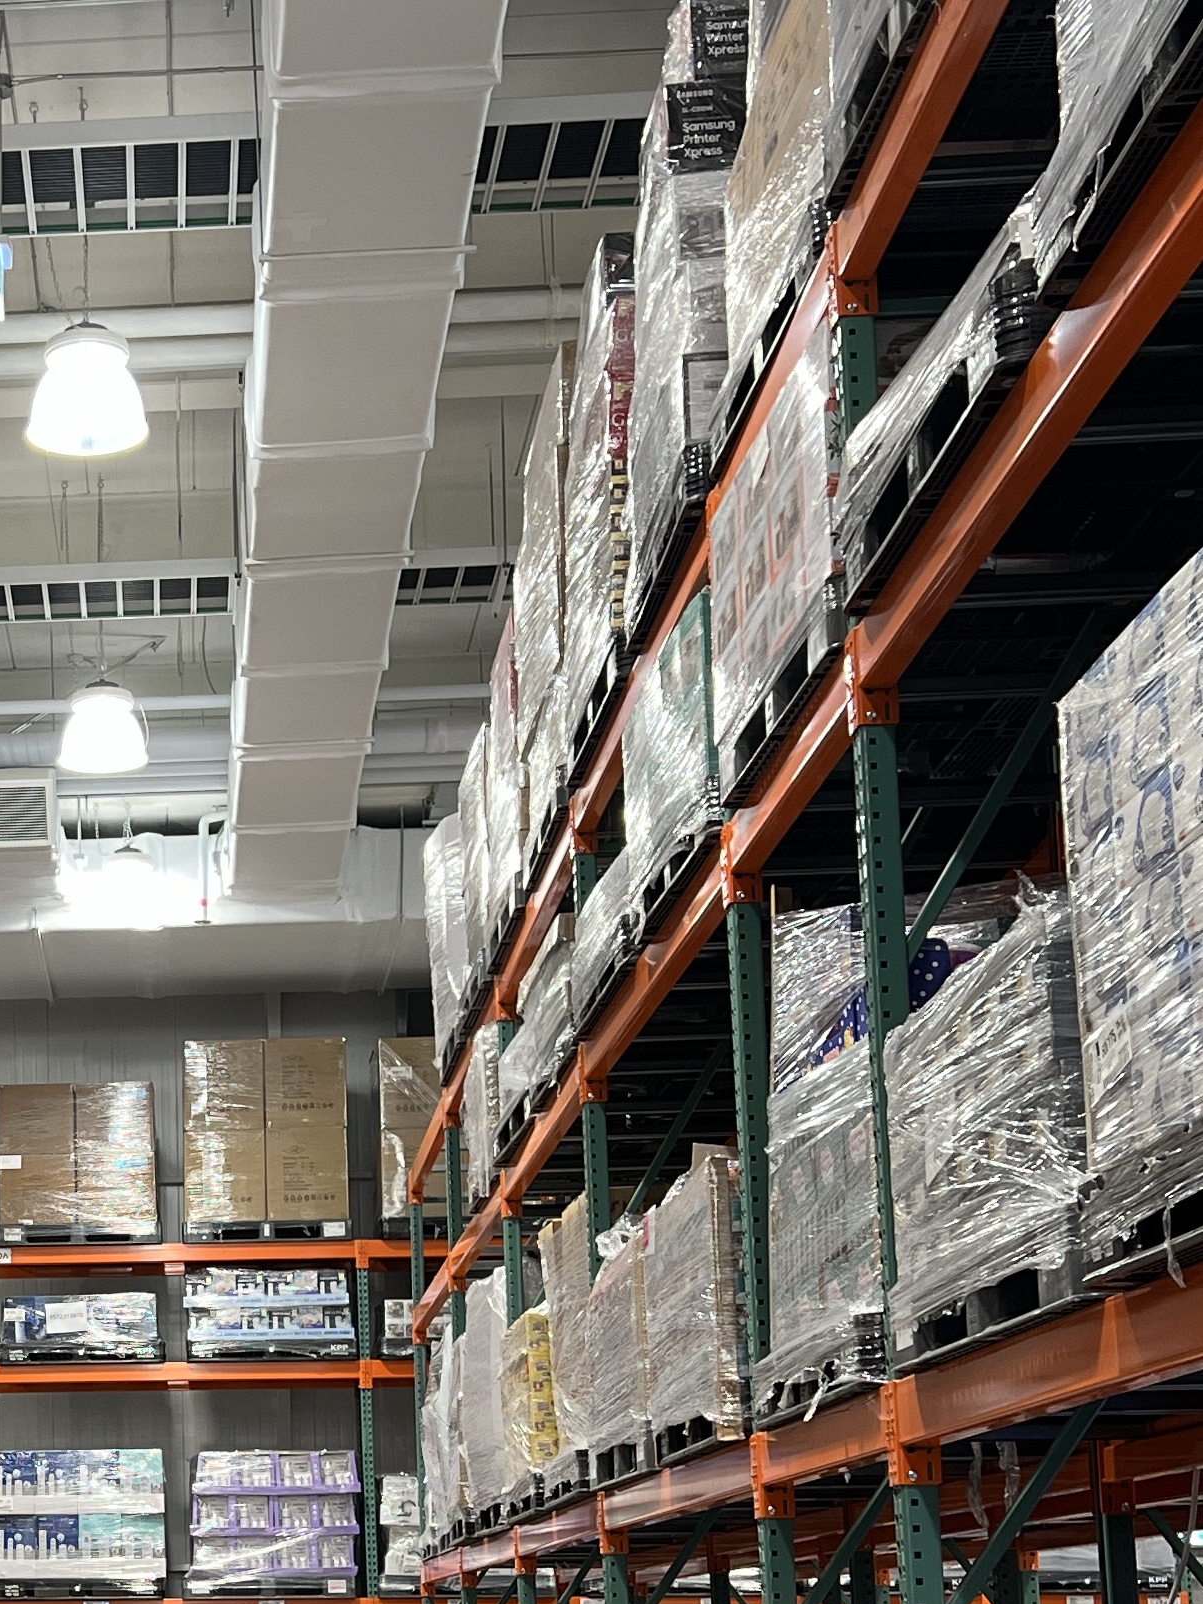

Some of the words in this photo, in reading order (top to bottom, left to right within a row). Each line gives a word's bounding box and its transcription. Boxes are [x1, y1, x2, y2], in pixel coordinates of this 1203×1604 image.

[707, 43, 746, 57] Xpress
[682, 119, 736, 133] Samsung
[683, 133, 722, 145] Printer
[683, 145, 724, 160] Xpress
